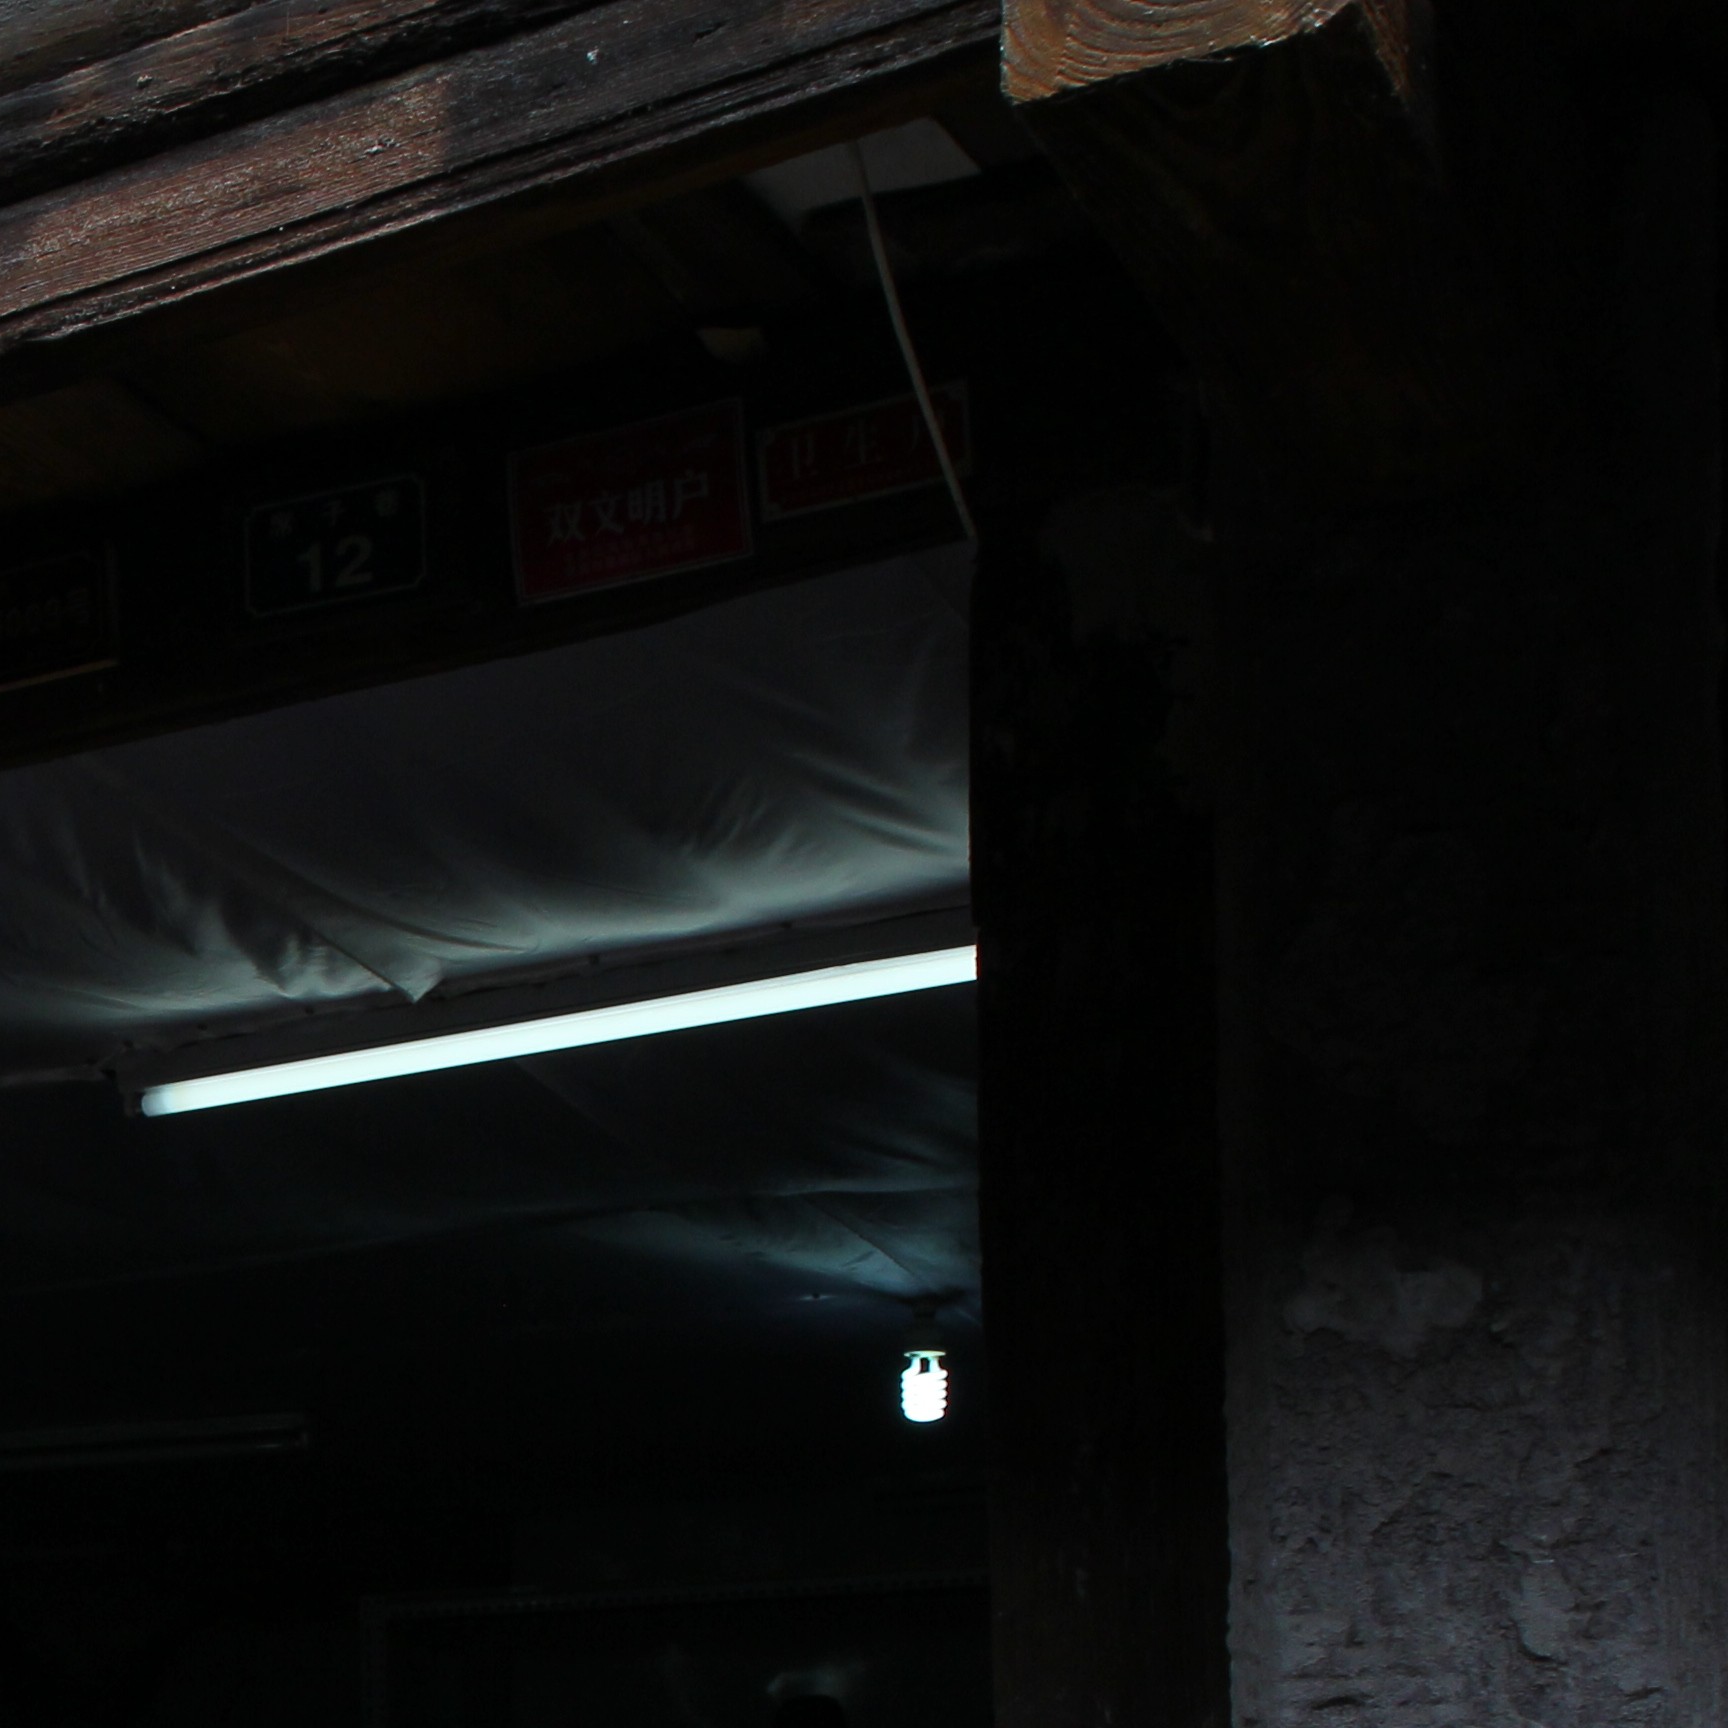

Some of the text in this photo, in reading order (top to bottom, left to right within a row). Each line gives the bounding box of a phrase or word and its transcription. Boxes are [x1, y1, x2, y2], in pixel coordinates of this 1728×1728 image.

[542, 467, 710, 547] 双文明户
[295, 533, 374, 595] 12
